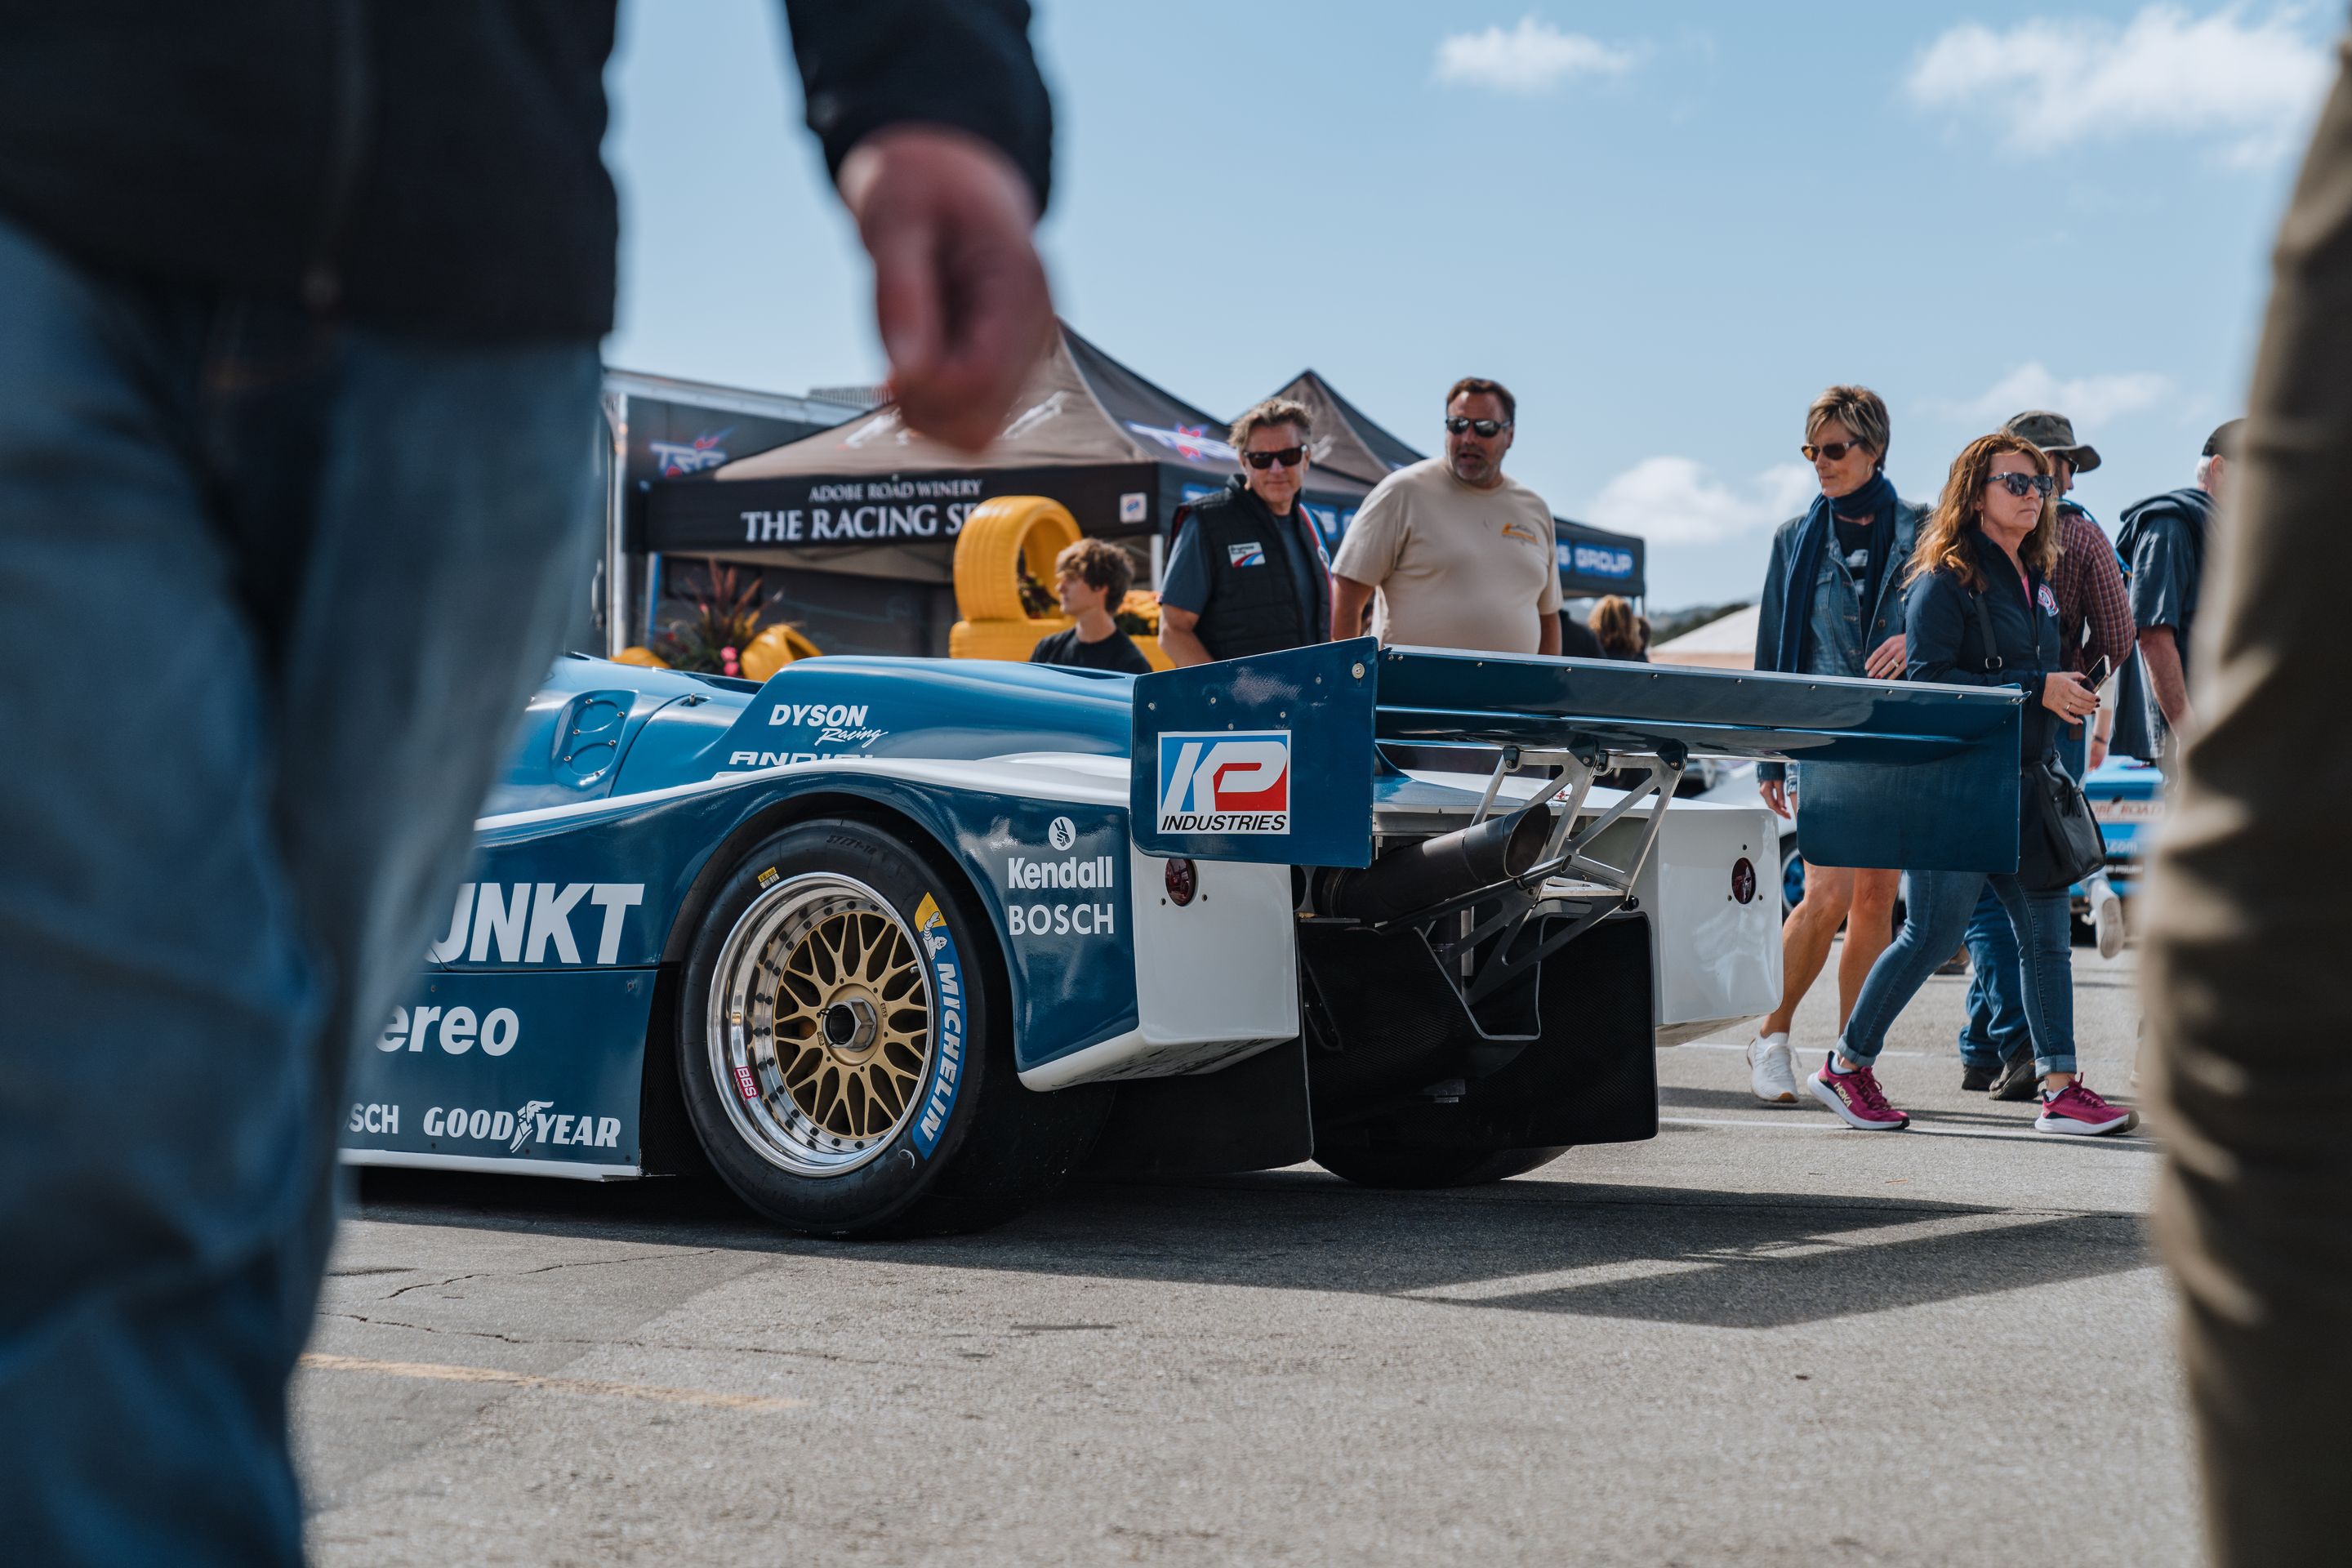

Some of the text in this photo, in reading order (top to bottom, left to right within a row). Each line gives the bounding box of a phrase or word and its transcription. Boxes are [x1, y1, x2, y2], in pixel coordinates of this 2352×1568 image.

[808, 479, 983, 502] ADOBE ROAD WINERY
[740, 510, 803, 541] THE
[811, 504, 938, 540] RACING
[768, 704, 869, 727] DYSON
[814, 726, 889, 748] Racing
[1161, 814, 1287, 831] INDUSTRIES
[1008, 856, 1113, 889] Kendall
[425, 882, 645, 964] UNKT
[1009, 903, 1114, 936] BOSCH
[375, 1005, 519, 1057] ereo
[920, 963, 961, 1143] MICHELIN
[737, 1067, 757, 1097] BBS
[1833, 1082, 1854, 1108] HOKA
[349, 1102, 399, 1134] SCH
